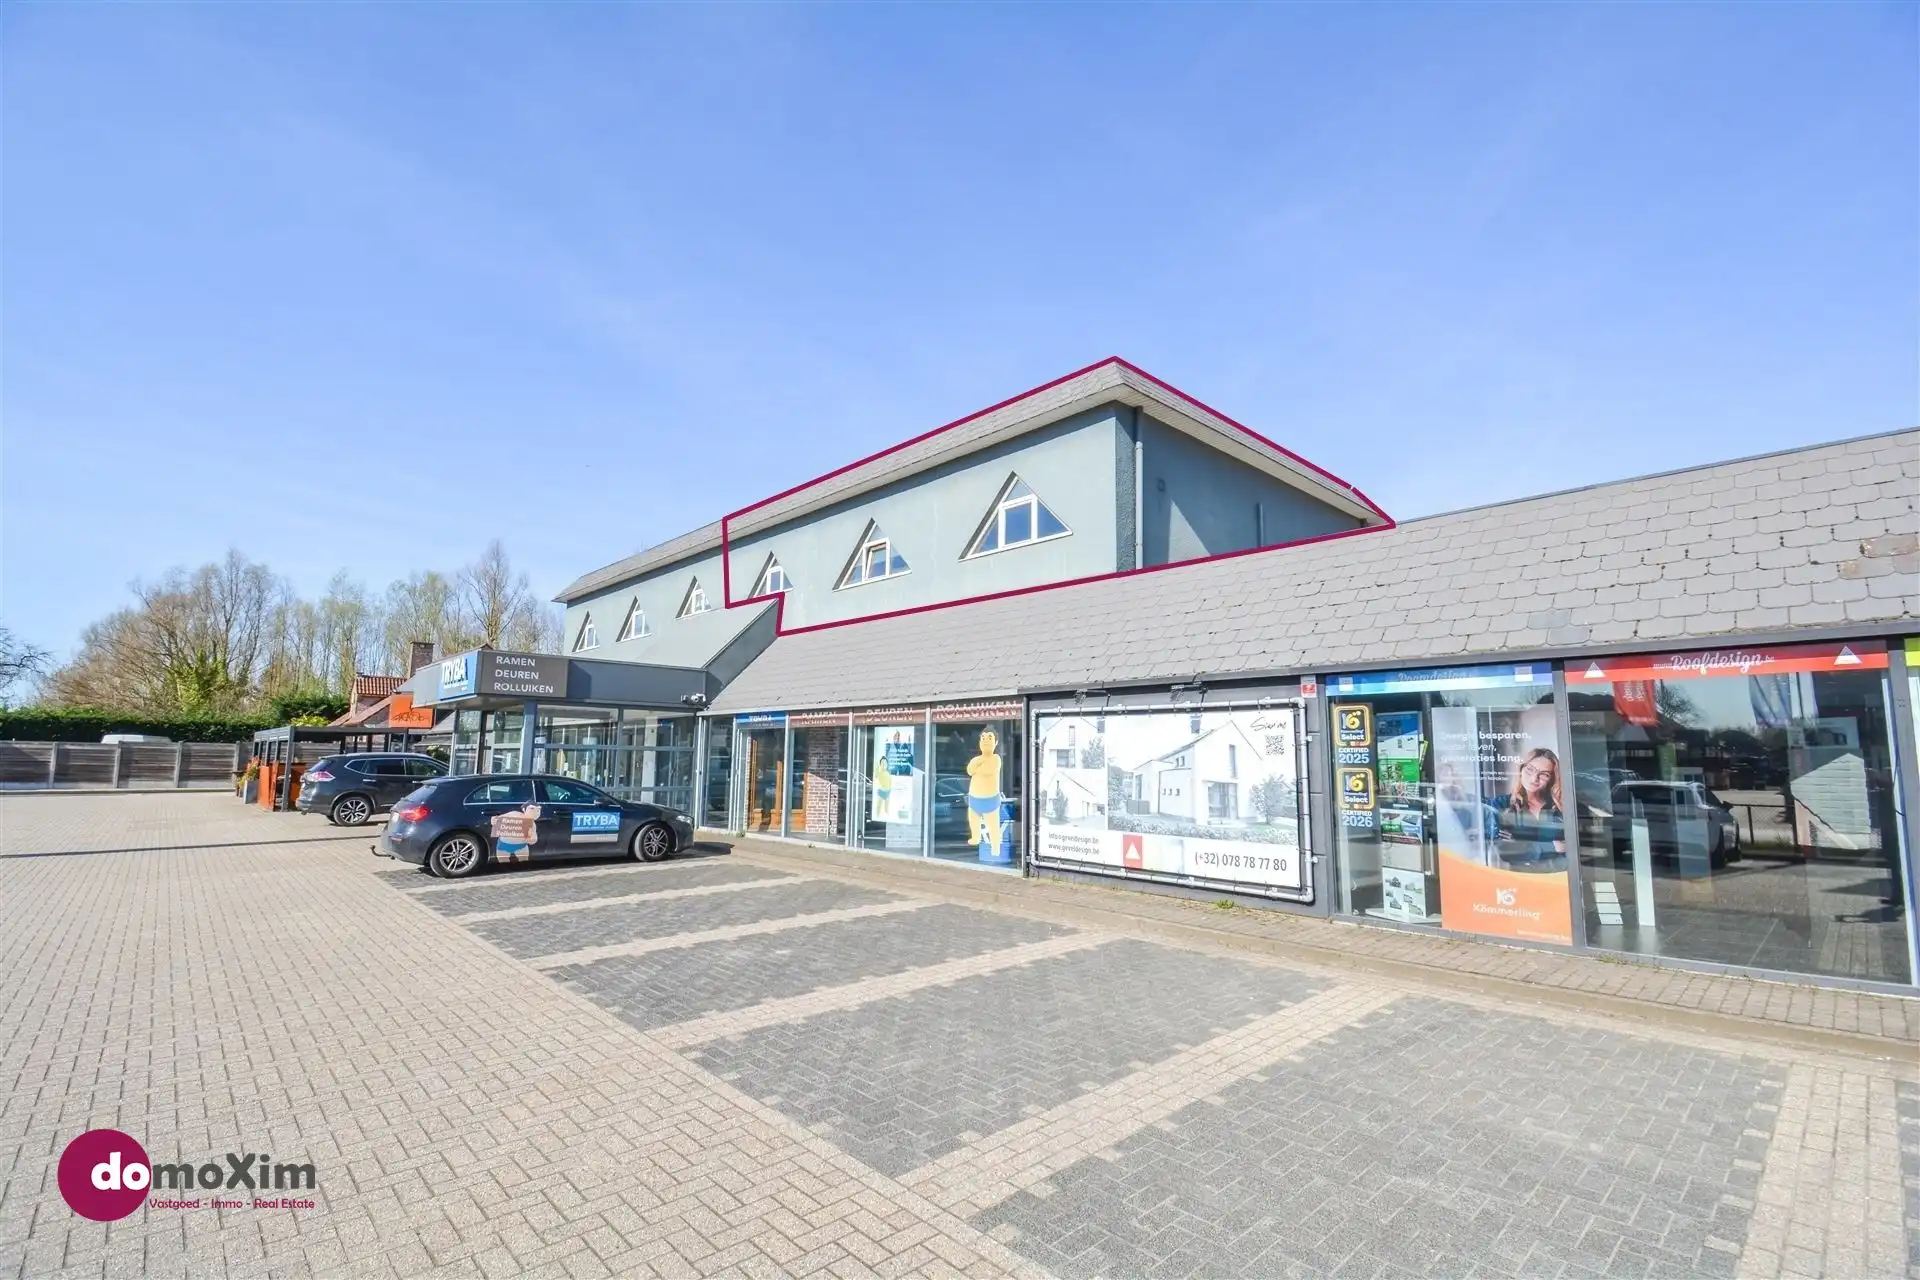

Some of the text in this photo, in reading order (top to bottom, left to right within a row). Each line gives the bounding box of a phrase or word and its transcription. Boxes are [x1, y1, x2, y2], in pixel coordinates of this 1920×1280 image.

[496, 656, 536, 667] RAMEN
[442, 657, 466, 683] TRYBA
[495, 669, 540, 680] DEUREN
[494, 683, 554, 694] ROLLUIKEN
[1339, 754, 1370, 763] 2025
[576, 815, 618, 826] TRYBA
[1342, 816, 1373, 827] 2026
[1195, 852, 1287, 871] (+32) 078 78 77 80
[1472, 903, 1540, 921] Kömmerling
